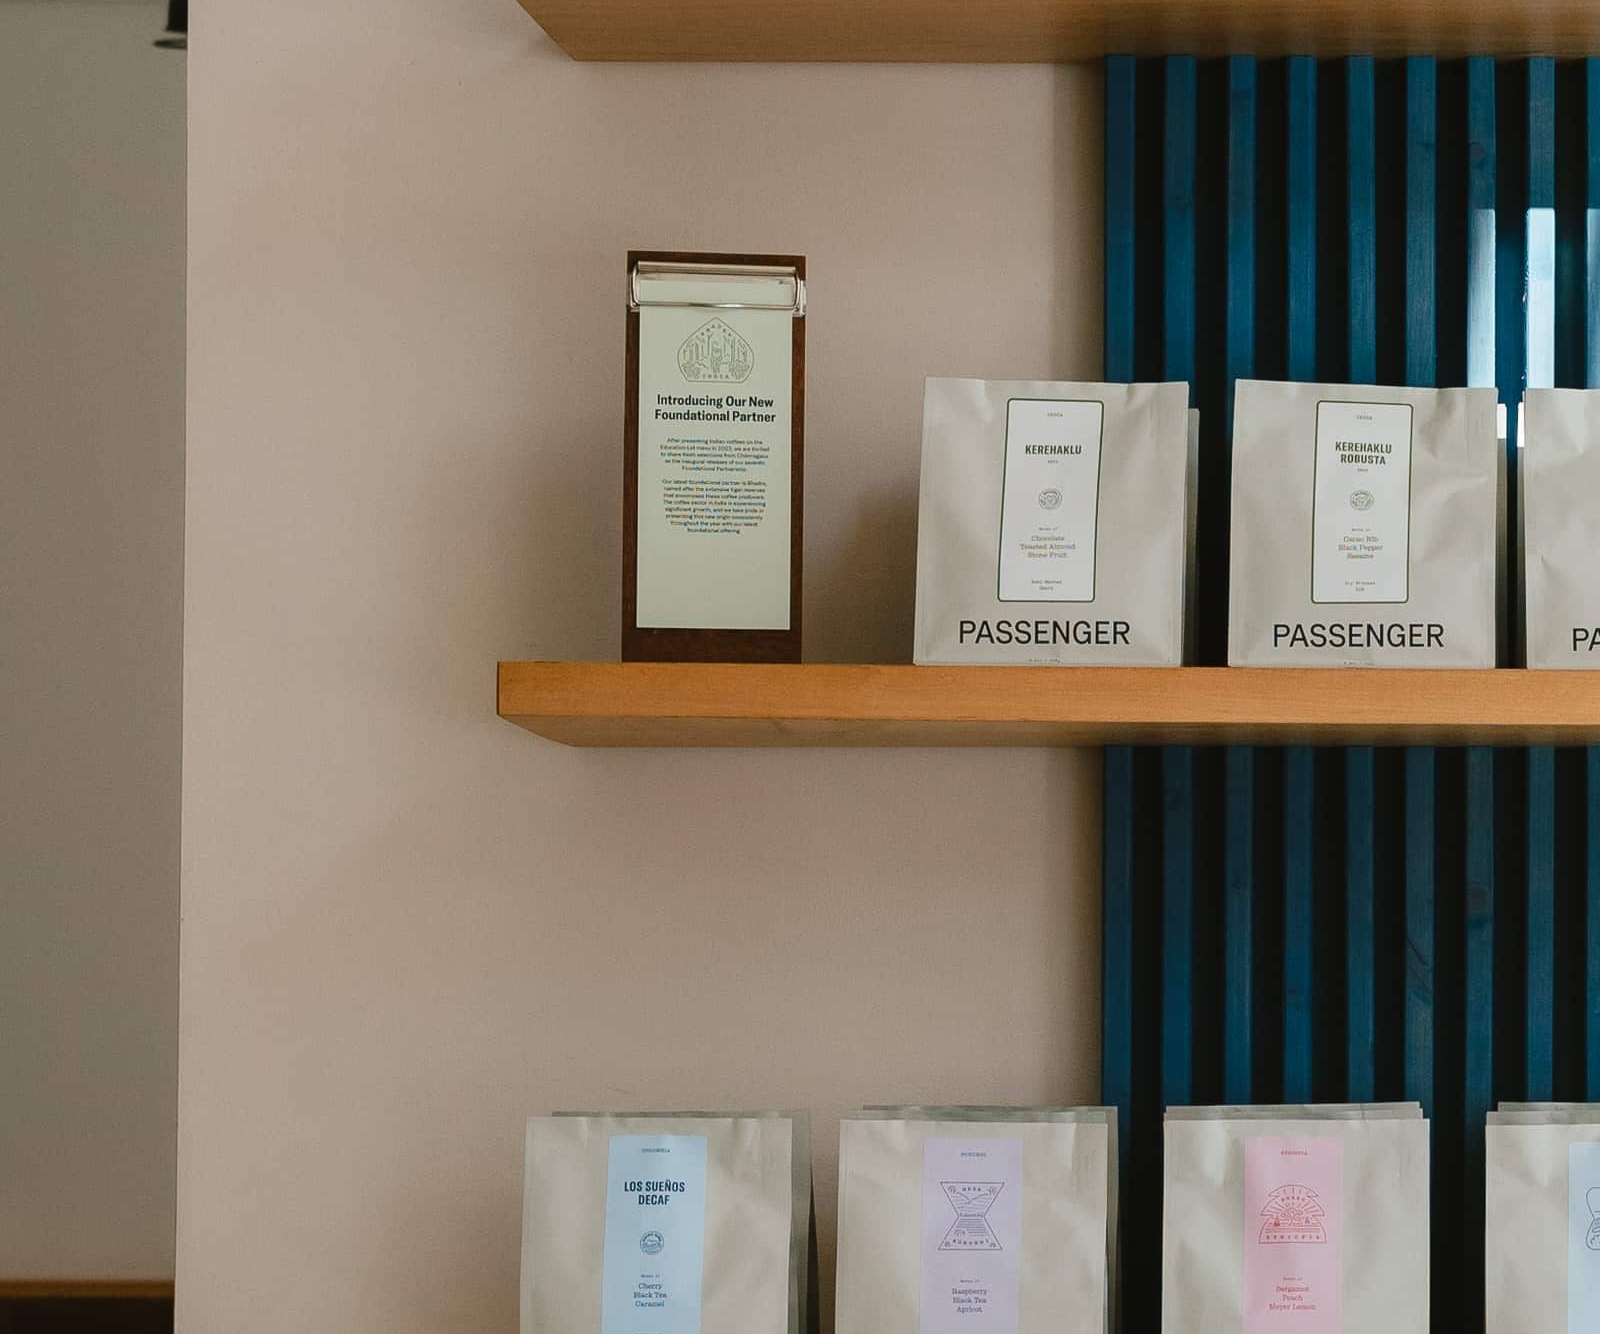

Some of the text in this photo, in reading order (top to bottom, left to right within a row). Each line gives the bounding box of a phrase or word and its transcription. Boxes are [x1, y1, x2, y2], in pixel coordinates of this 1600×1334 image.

[657, 394, 773, 408] Introducing Our New
[655, 409, 776, 422] Foundational Partner
[1025, 445, 1082, 455] KEREHAKLU
[1335, 441, 1392, 454] KEREHAKLU
[1340, 454, 1386, 465] ROBUSTA
[960, 621, 1129, 644] PASSENGER
[1274, 624, 1443, 647] PASSENGER
[624, 1179, 685, 1192] LOS SUEÑOS
[638, 1195, 670, 1205] DECAF
[638, 1282, 663, 1290] Cherry
[633, 1291, 652, 1299] Black
